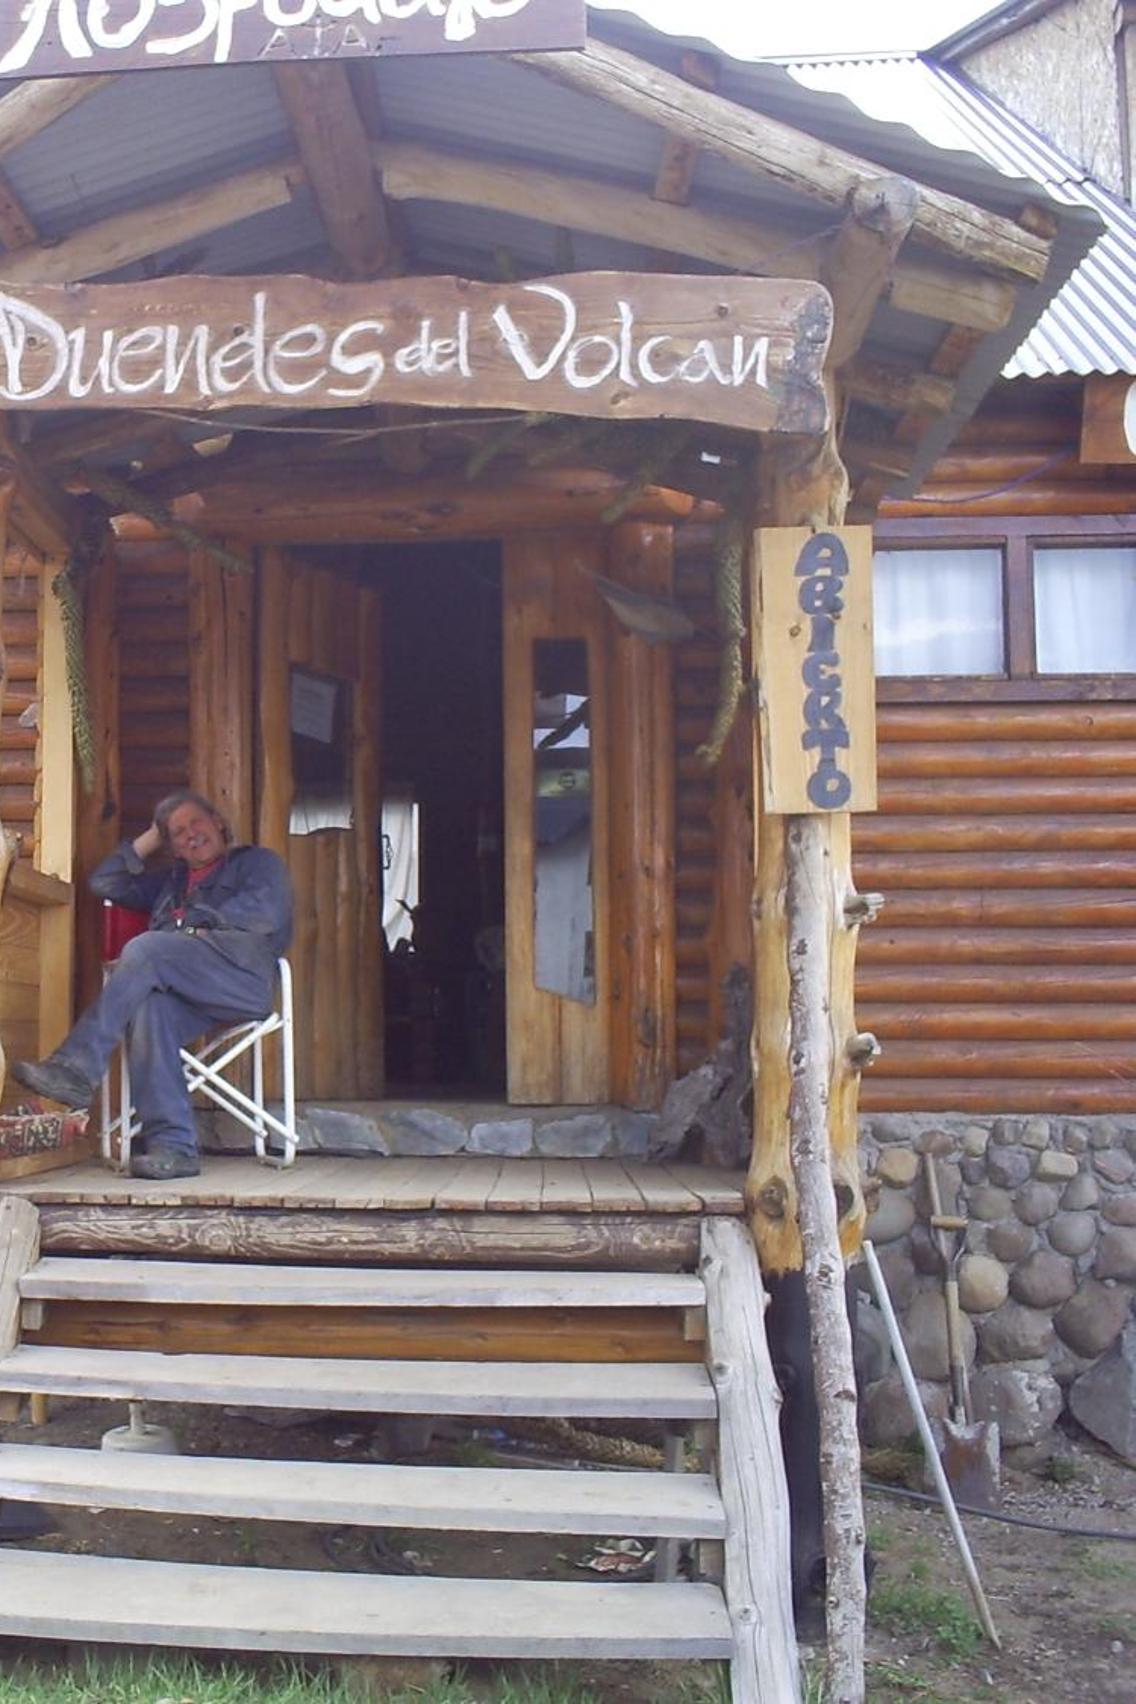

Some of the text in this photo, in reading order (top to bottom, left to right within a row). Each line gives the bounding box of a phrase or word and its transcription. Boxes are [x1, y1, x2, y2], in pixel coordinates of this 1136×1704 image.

[394, 311, 472, 377] del
[492, 283, 770, 389] Volcan
[794, 532, 851, 809] ABIERTO
